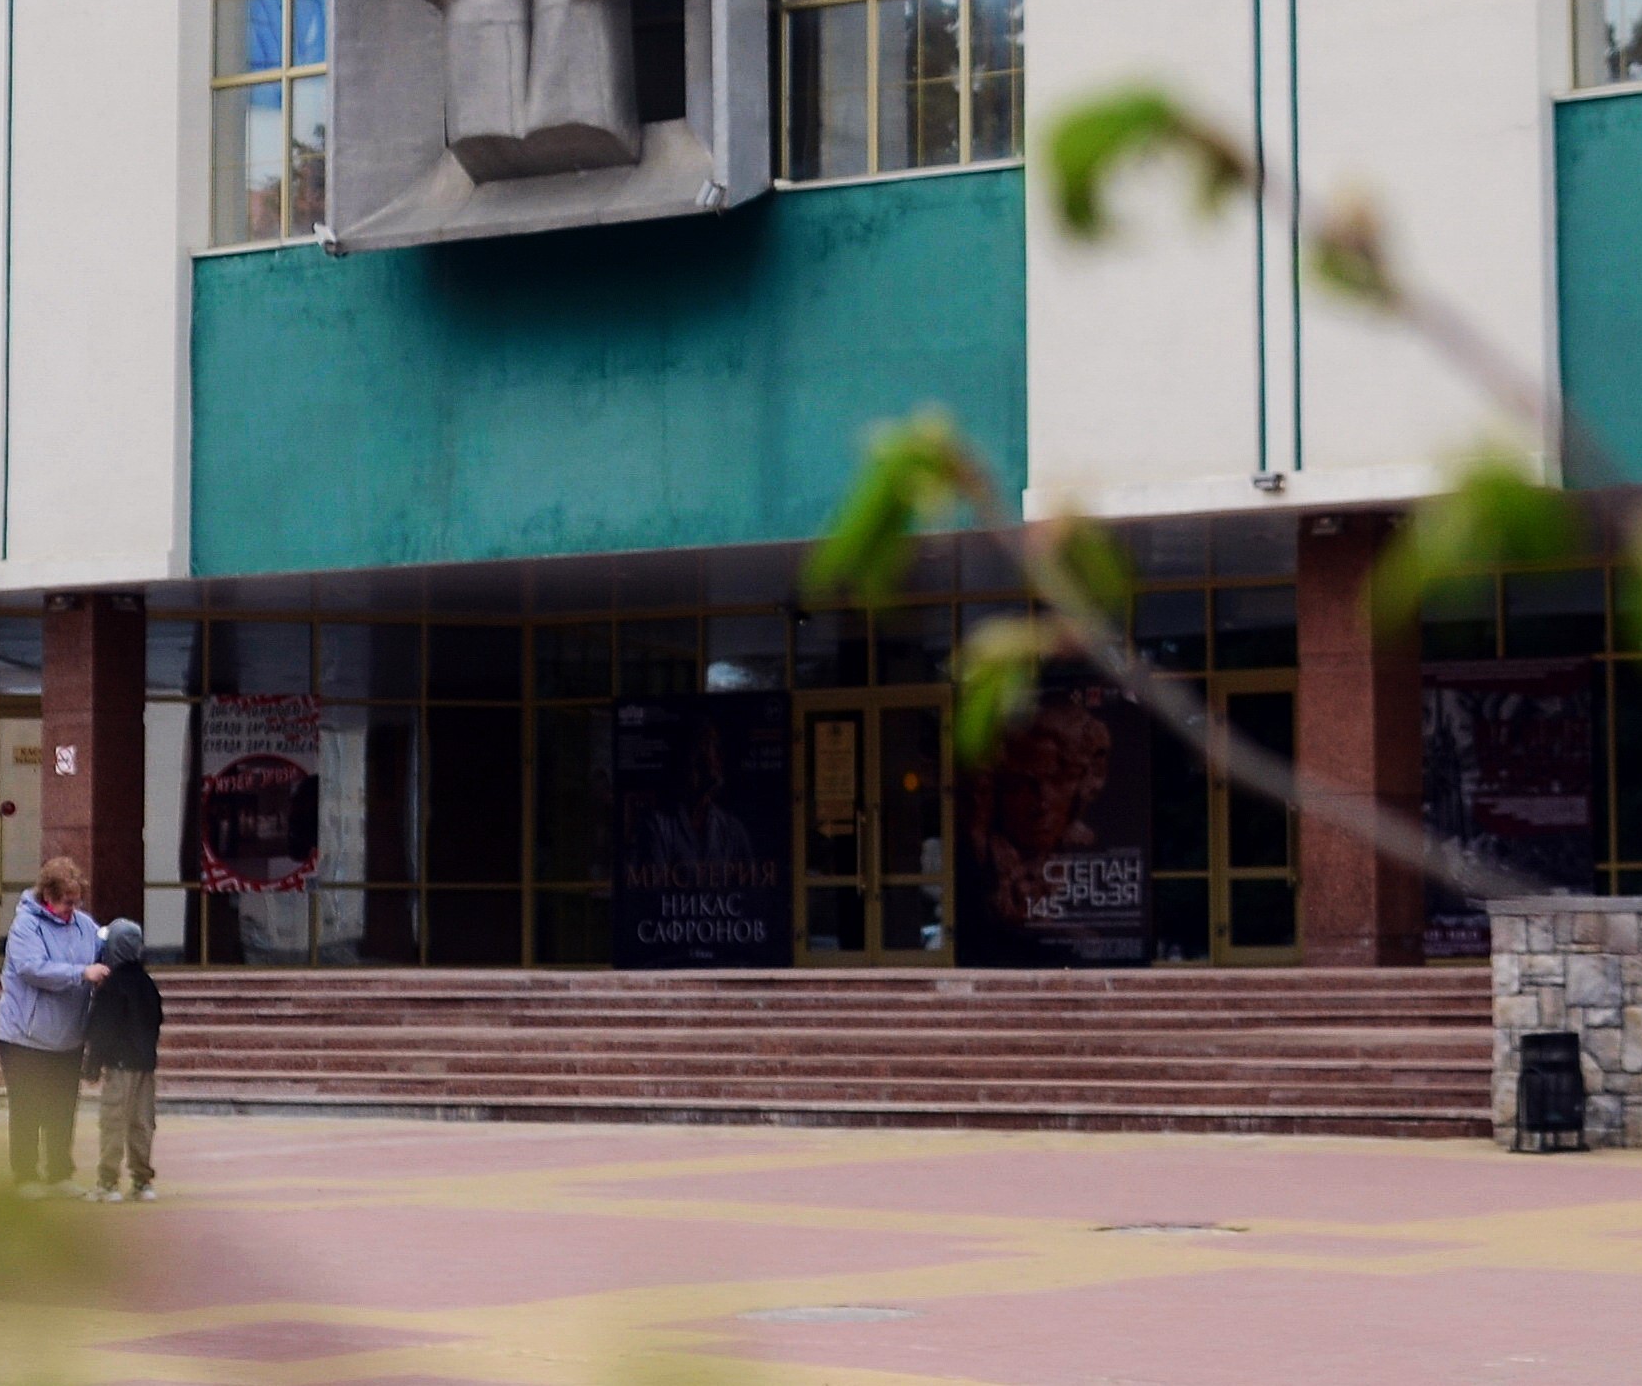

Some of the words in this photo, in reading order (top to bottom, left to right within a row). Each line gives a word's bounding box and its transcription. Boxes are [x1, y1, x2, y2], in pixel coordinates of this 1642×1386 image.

[626, 861, 778, 887] МИСТЕРИЯ
[1043, 860, 1141, 884] СТЕПАН
[661, 893, 743, 917] НИКАС
[1025, 896, 1063, 919] 145
[637, 920, 767, 944] САФРОНОВ
